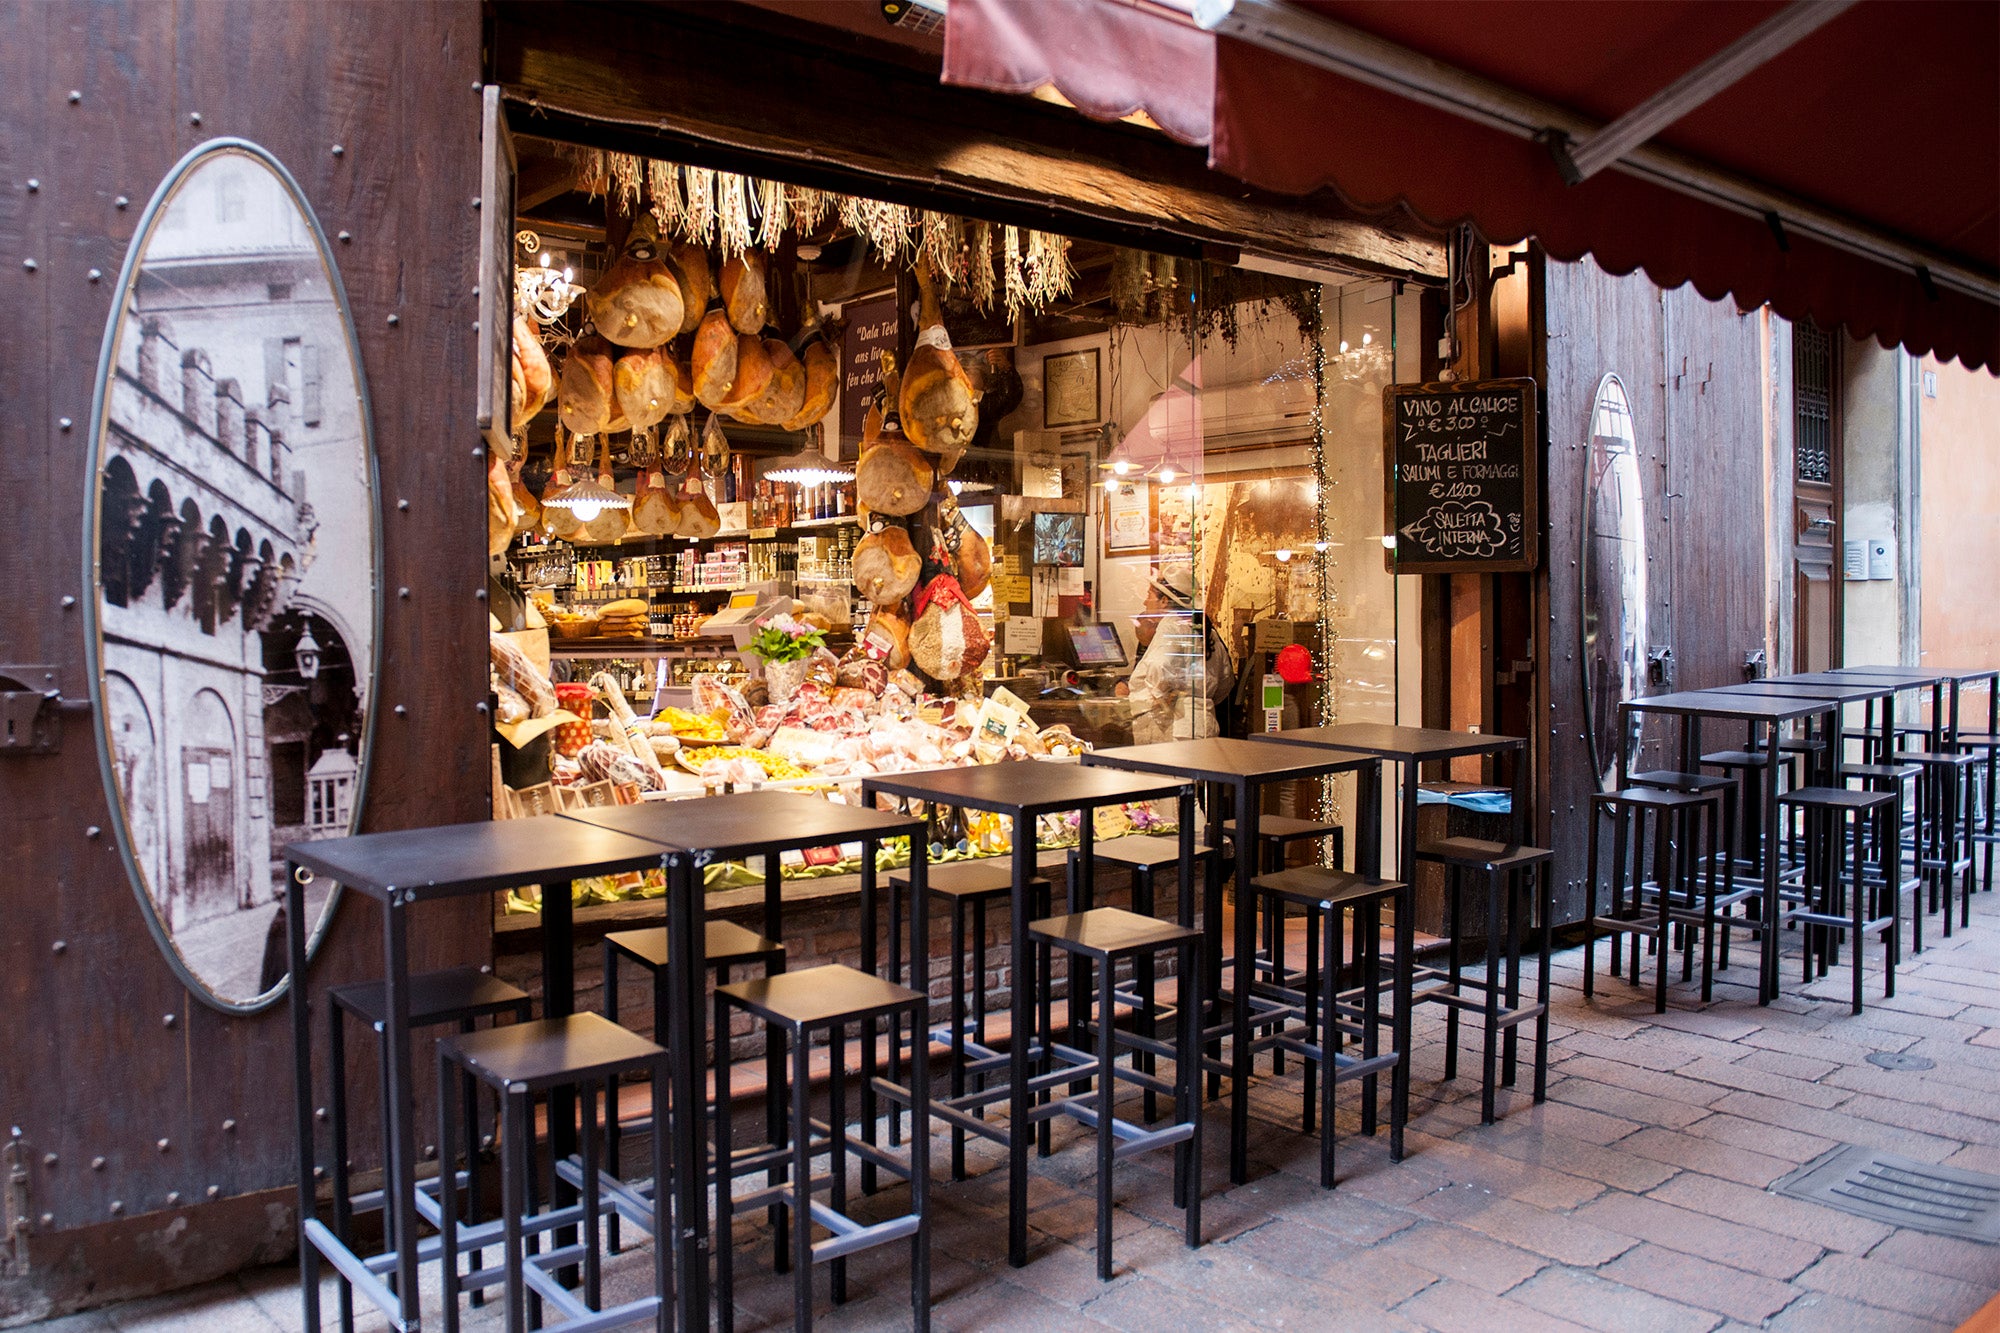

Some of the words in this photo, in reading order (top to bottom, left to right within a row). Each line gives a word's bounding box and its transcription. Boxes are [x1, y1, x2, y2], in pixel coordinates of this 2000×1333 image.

[882, 319, 898, 337] Tèvl
[855, 351, 869, 364] ans
[860, 368, 875, 386] che
[861, 395, 871, 407] an
[1403, 399, 1442, 417] VINO
[1448, 397, 1469, 415] AL
[1470, 396, 1518, 413] CALICE
[1415, 435, 1487, 462] TAGLIERI
[1402, 464, 1441, 482] SALUMI
[1447, 465, 1457, 479] E
[1462, 463, 1519, 479] FORMAGGI
[1434, 511, 1486, 529] SALETTA
[1439, 530, 1491, 545] INTERNA
